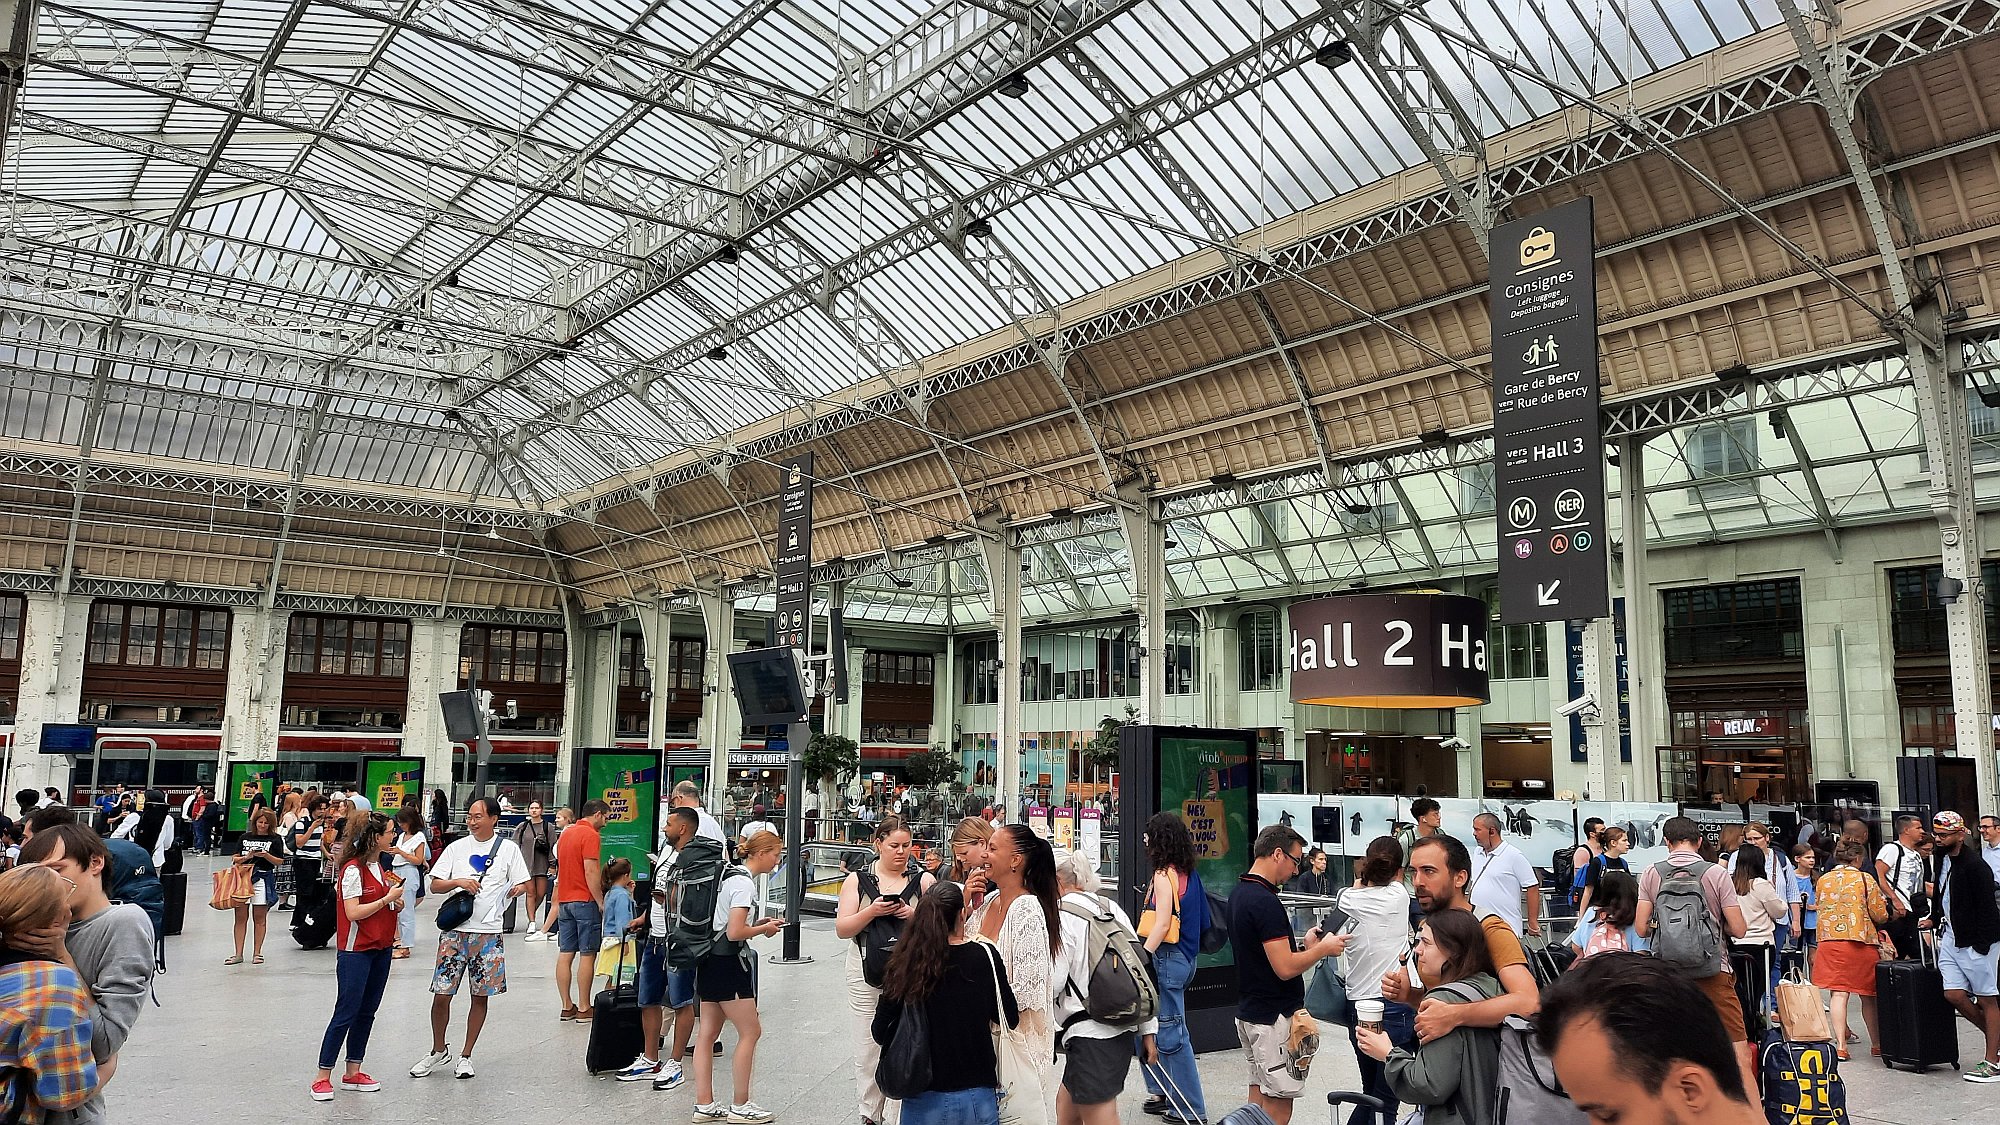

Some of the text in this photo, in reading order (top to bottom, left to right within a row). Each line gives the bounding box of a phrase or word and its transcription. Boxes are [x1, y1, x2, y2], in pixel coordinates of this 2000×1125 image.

[1505, 270, 1574, 298] Consignes
[1518, 290, 1560, 306] Left luggage
[1510, 303, 1541, 318] Deposito
[1504, 371, 1580, 395] Gare de Bercy
[1518, 397, 1538, 409] Rue
[1541, 393, 1554, 403] de
[1558, 386, 1588, 400] Bercy
[1507, 438, 1584, 461] vers Hall 3
[1514, 503, 1530, 522] M
[1559, 498, 1580, 512] RER
[1517, 543, 1530, 554] 14
[1555, 537, 1586, 549] A D
[788, 583, 799, 593] Hall
[800, 582, 803, 591] 3
[1383, 620, 1414, 666] 2
[1441, 623, 1488, 671] Ha
[1724, 719, 1756, 735] RELAY
[1187, 804, 1205, 816] HEY,
[1190, 819, 1215, 830] C'EST
[1698, 824, 1721, 832] OCEA
[1196, 831, 1216, 841] VOUS
